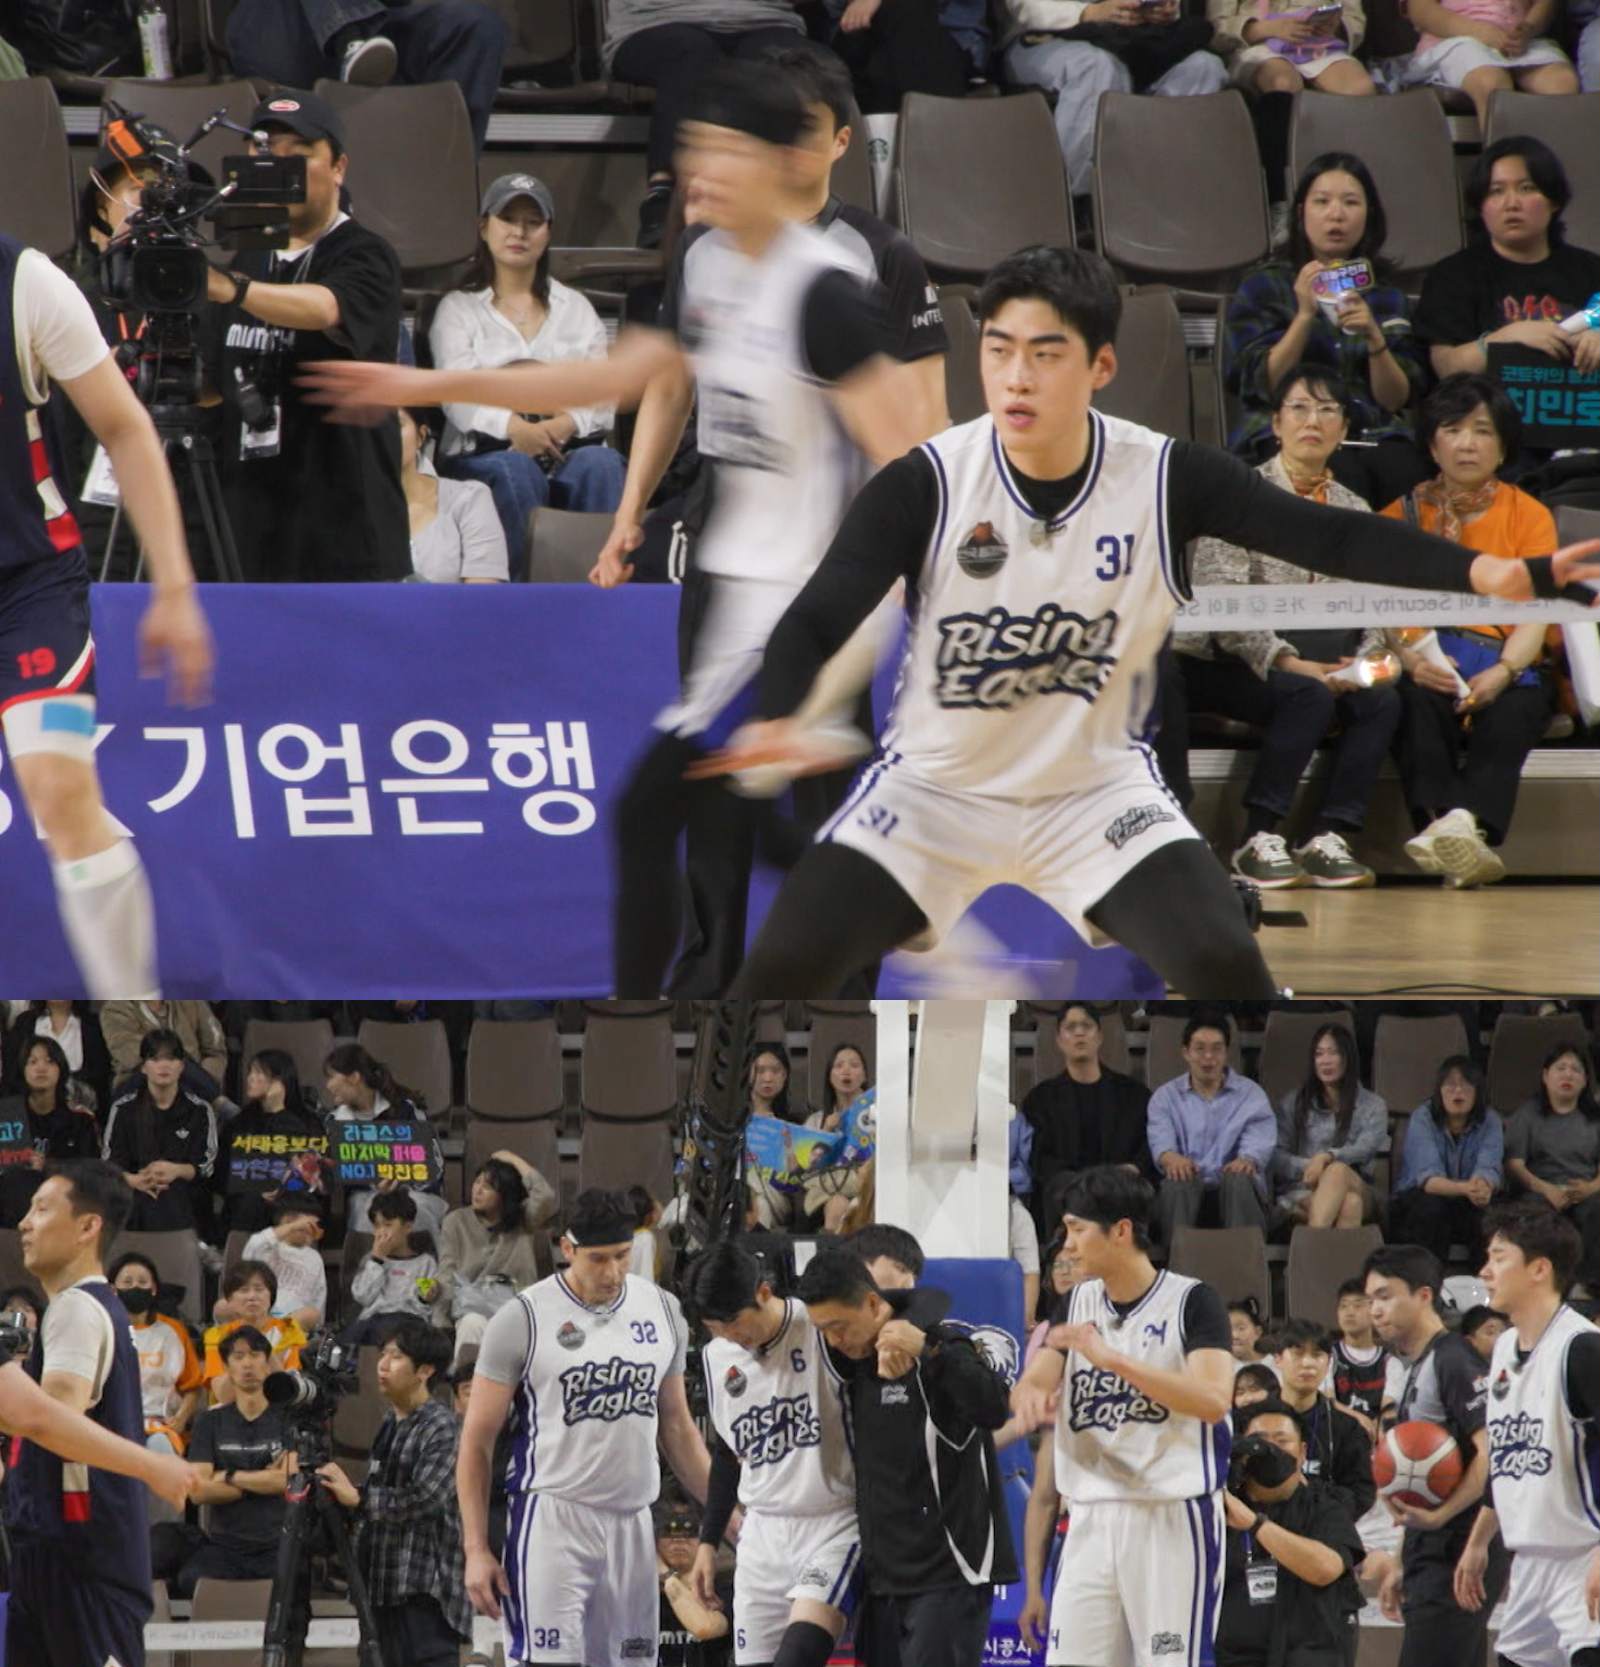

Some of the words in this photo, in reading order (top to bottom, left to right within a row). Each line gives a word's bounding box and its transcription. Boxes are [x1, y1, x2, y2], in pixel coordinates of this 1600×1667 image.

[1096, 534, 1135, 581] 31
[17, 648, 57, 679] 19
[144, 719, 597, 838] 기업은행
[630, 1320, 658, 1344] 32
[562, 1357, 655, 1400] Rising
[533, 1627, 562, 1649] 32
